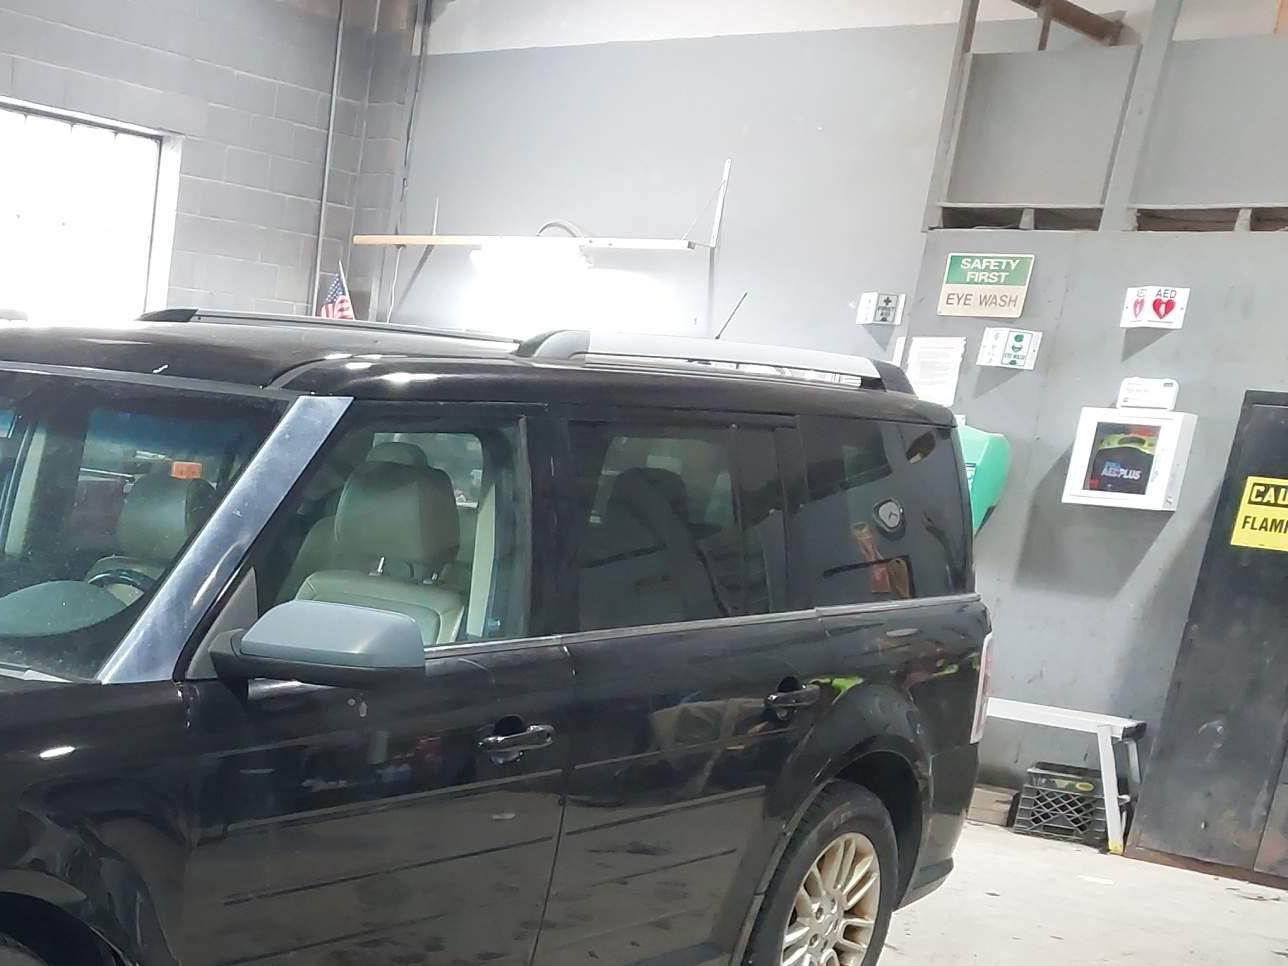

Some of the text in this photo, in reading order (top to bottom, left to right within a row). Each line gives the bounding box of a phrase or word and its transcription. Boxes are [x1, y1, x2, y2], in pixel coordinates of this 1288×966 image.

[960, 258, 1020, 270] SAFETY
[966, 271, 1009, 283] FIRST
[1155, 288, 1177, 299] AED
[945, 293, 1019, 308] EYE WASH
